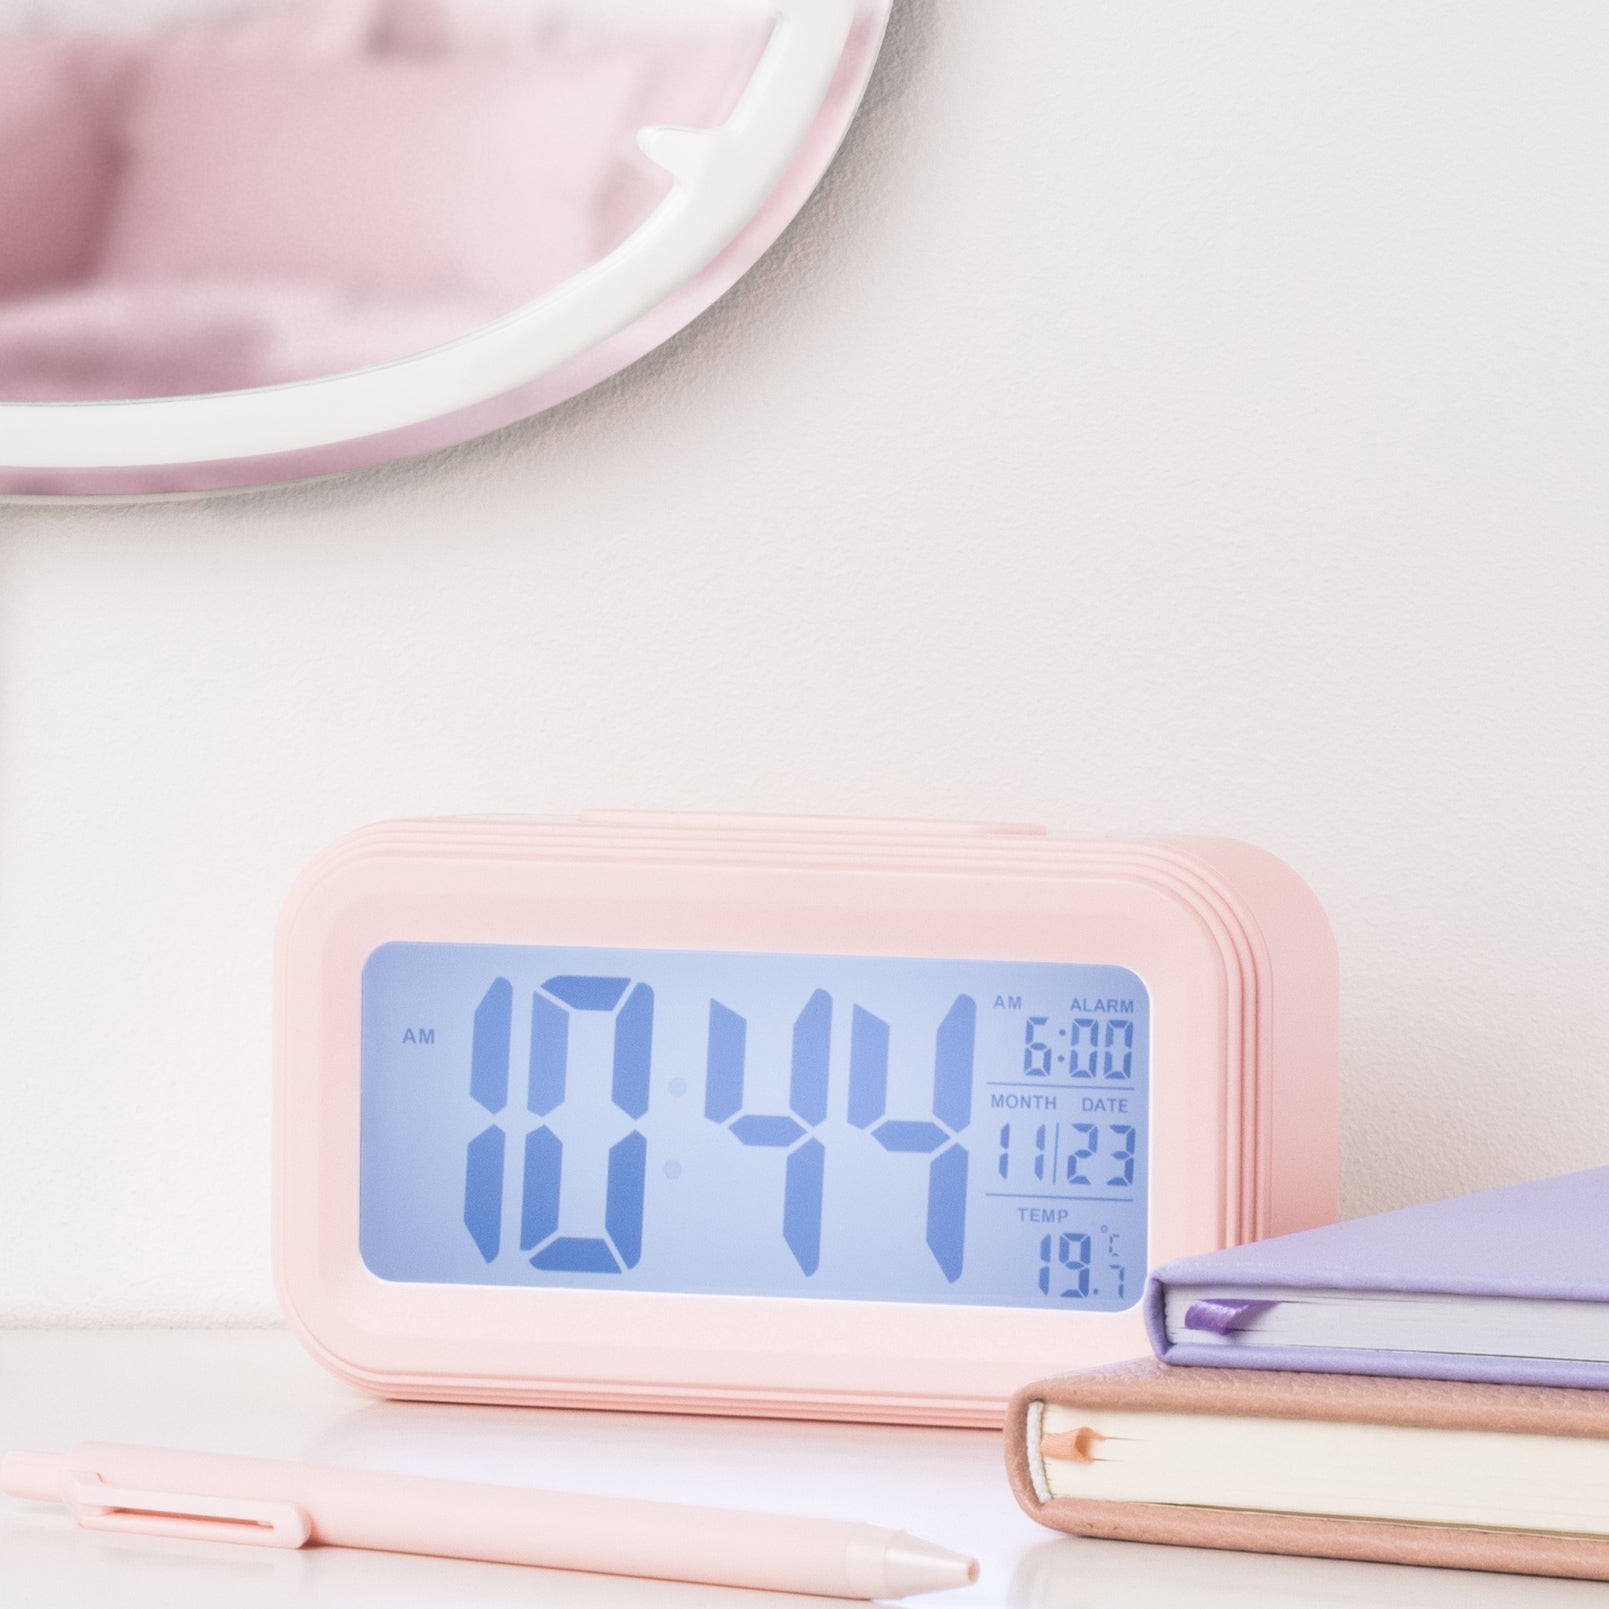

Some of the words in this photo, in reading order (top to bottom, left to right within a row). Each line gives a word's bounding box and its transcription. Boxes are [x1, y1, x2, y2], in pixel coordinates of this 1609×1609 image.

[993, 995, 1022, 1010] AM
[1070, 998, 1134, 1014] ALARM
[402, 1028, 435, 1045] AM
[1024, 1017, 1134, 1080] 6:00
[991, 1094, 1057, 1110] MONTH
[1082, 1097, 1128, 1113] DATE
[1067, 1122, 1136, 1187] 23
[1017, 1207, 1068, 1223] TEMP
